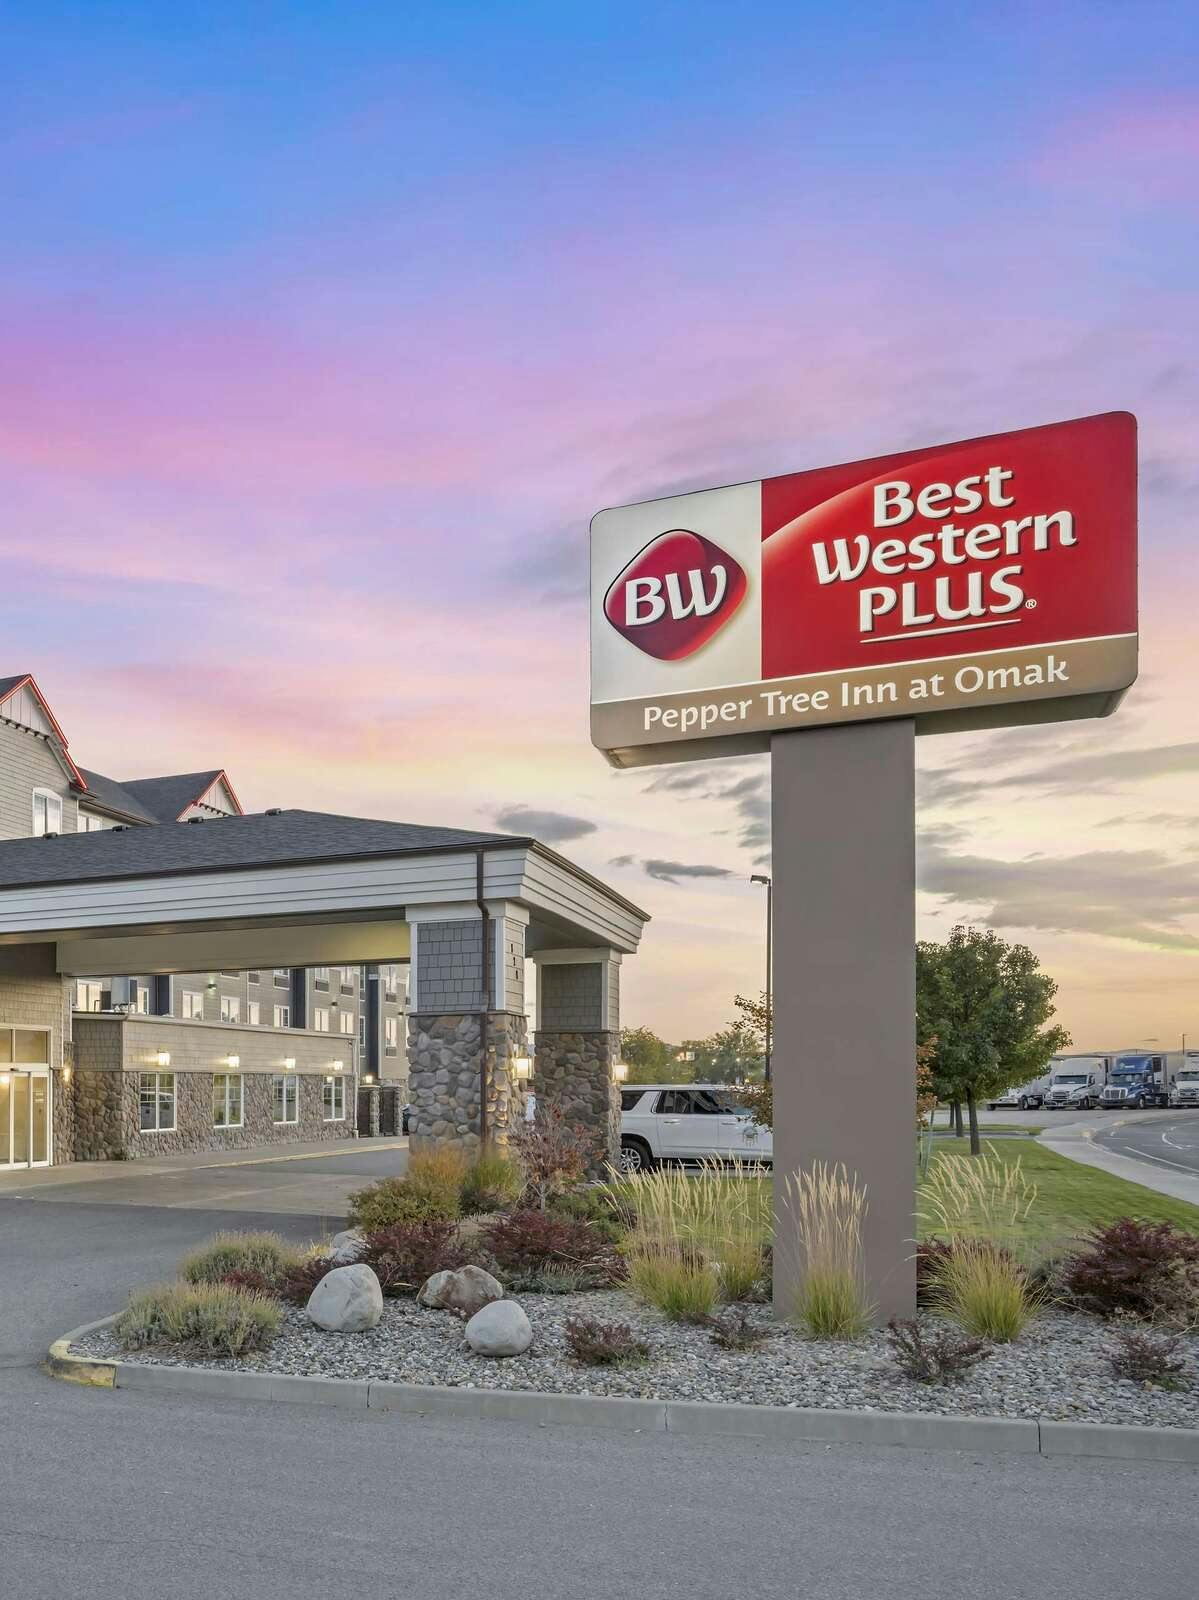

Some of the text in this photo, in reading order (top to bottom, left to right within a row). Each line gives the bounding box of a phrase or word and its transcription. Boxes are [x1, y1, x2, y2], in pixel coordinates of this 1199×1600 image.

[873, 466, 1014, 528] Best
[812, 510, 1077, 585] Western
[625, 564, 727, 626] BW
[643, 655, 1070, 732] Pepper Tree Inn at Omak
